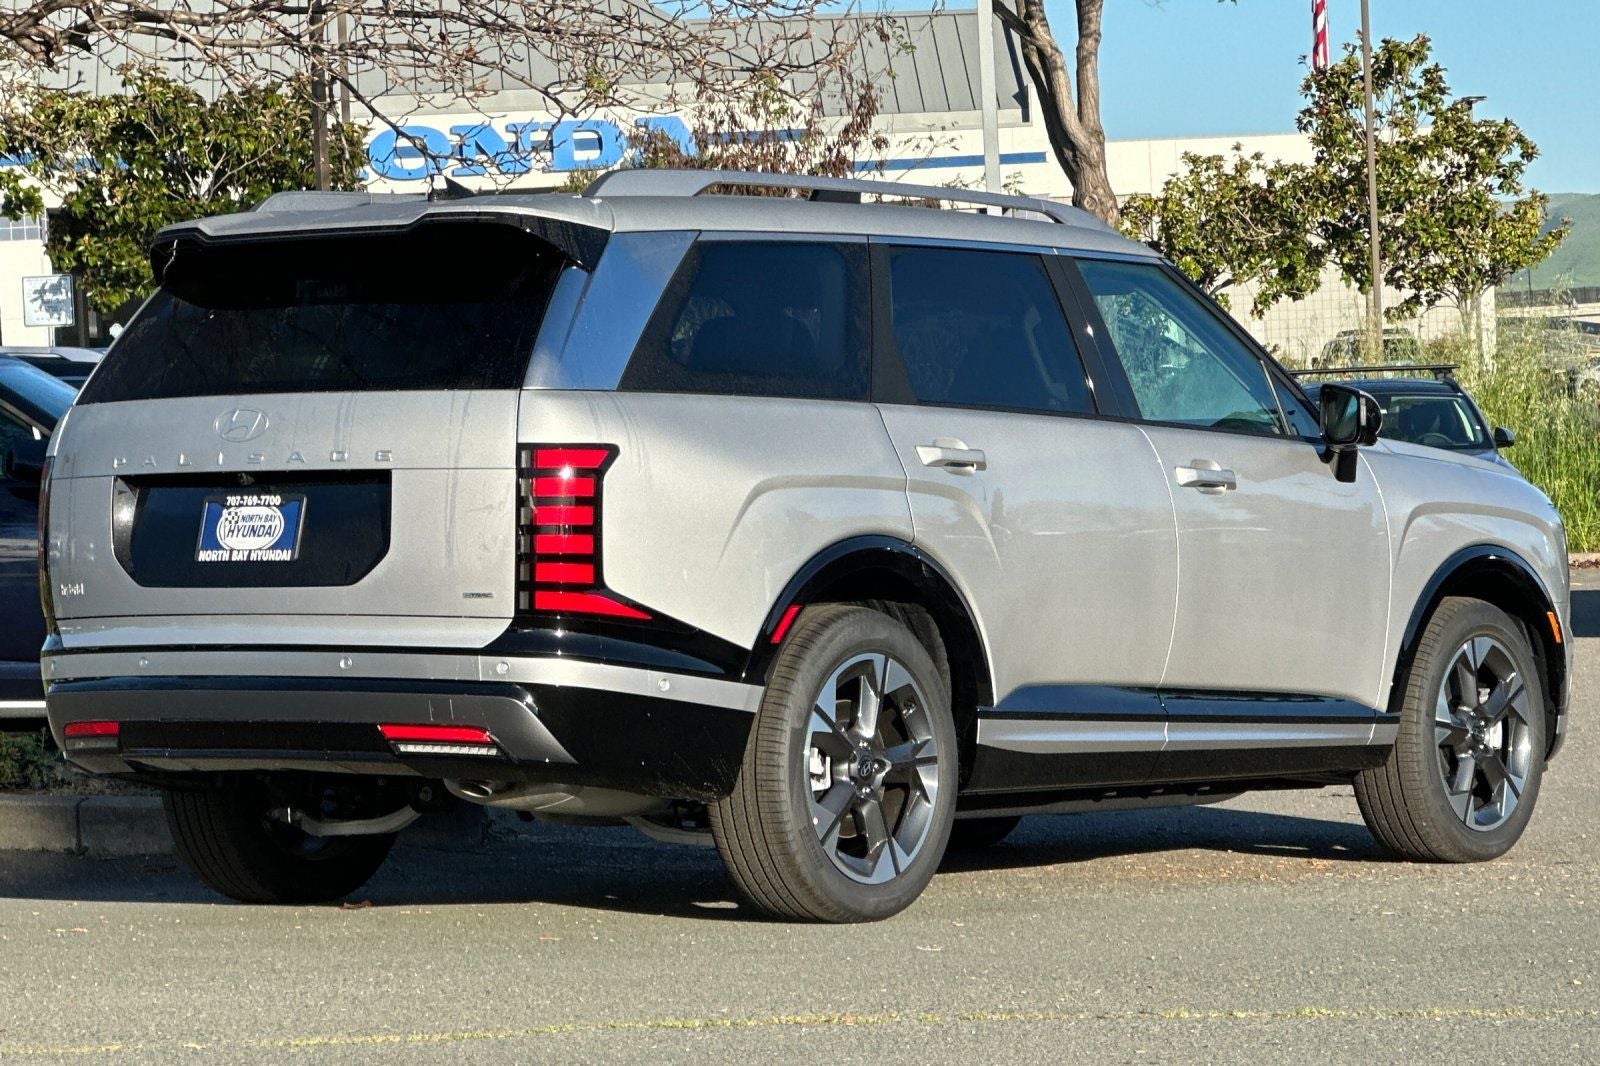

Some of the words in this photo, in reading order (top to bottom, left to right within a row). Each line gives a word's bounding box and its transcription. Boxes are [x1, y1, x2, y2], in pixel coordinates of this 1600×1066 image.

[357, 115, 698, 181] ONDA
[112, 450, 394, 470] PALISADE
[226, 495, 281, 506] 707-769-7700
[240, 514, 263, 524] NORTH
[263, 514, 278, 523] BAY
[226, 524, 278, 538] HYUNDAI
[198, 550, 228, 562] NORTH
[231, 550, 249, 561] BAY
[249, 549, 292, 561] HYUNDAI
